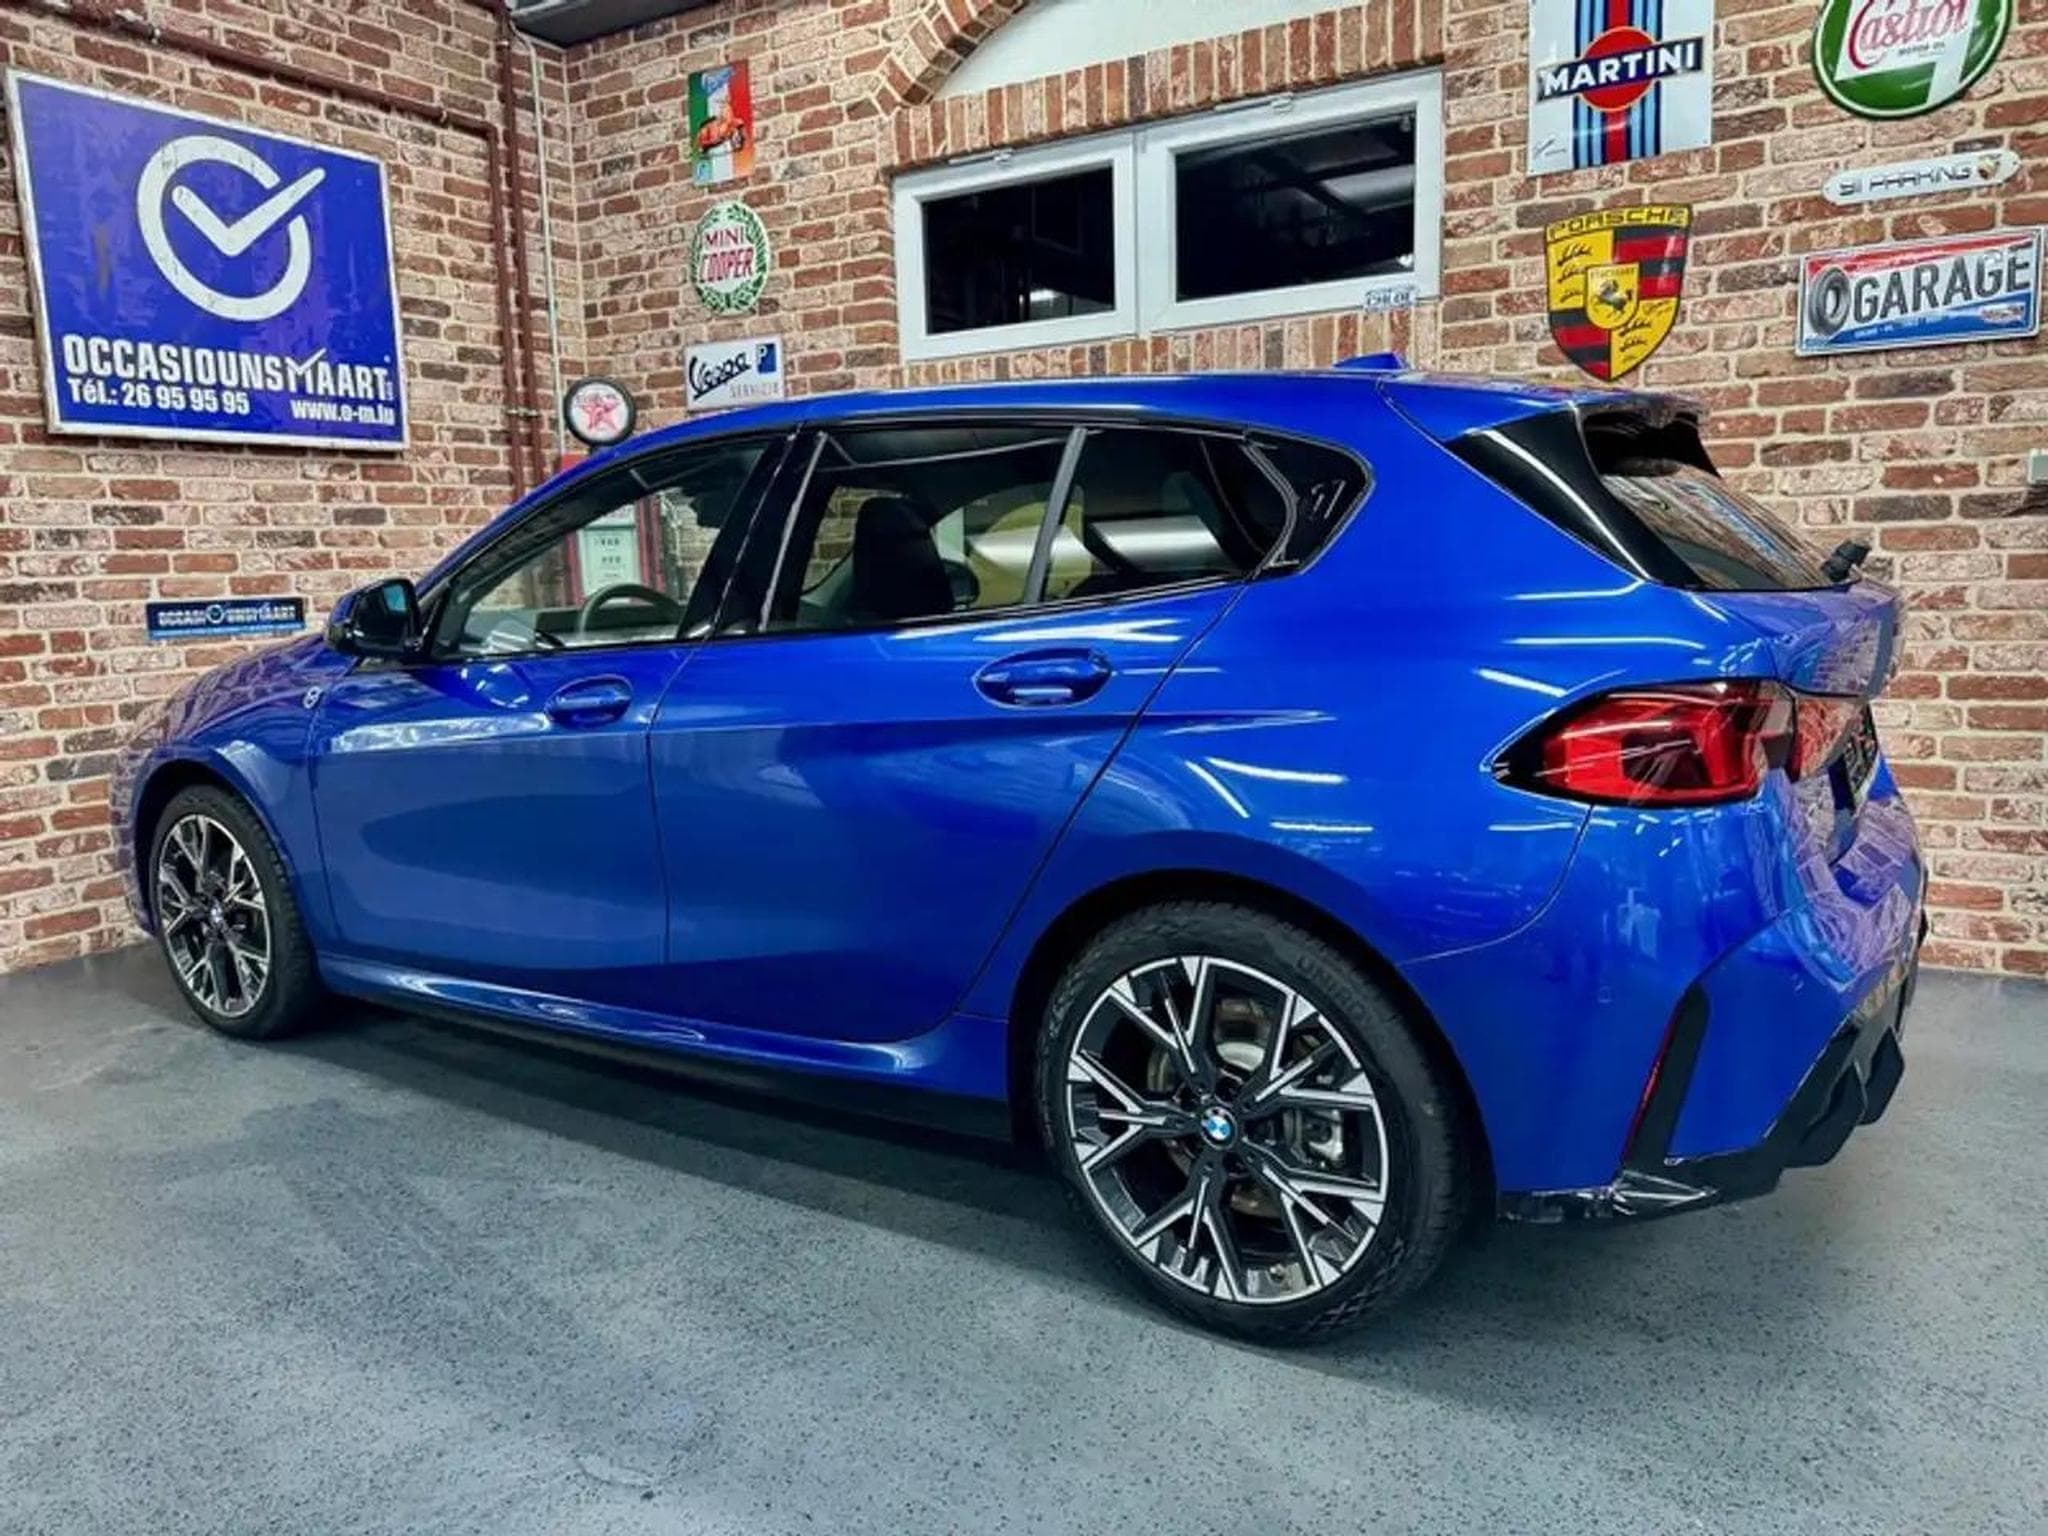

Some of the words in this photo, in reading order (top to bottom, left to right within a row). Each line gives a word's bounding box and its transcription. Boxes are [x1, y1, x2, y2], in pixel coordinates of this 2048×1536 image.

[1542, 43, 1695, 96] MARTINI
[1869, 163, 1972, 191] PARKING
[705, 226, 744, 249] MINI
[1548, 207, 1687, 239] PORSCHE
[700, 247, 753, 283] COOPER
[1853, 241, 2034, 323] GARAGE
[62, 333, 388, 401] OCCASIOUNSMAART
[689, 352, 752, 401] Vespa
[121, 381, 152, 409] 26
[155, 385, 187, 411] 95
[189, 388, 219, 413] 95
[222, 391, 250, 415] 95
